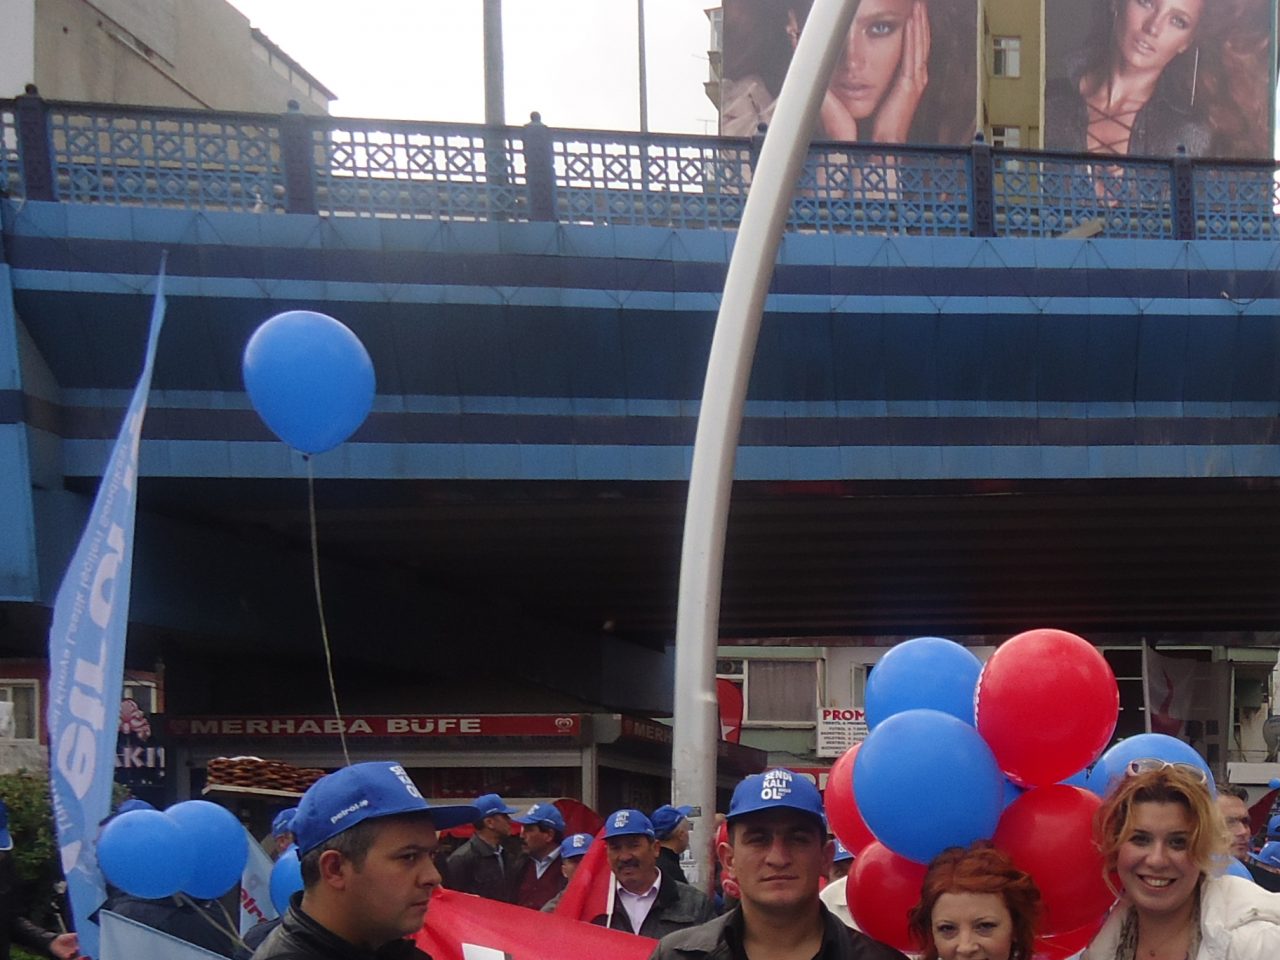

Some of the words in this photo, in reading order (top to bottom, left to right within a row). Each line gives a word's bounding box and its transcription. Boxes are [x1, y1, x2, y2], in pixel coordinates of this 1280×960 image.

[823, 709, 866, 721] PROM
[191, 719, 373, 733] MERHABA
[387, 718, 482, 733] BÜFE
[762, 778, 786, 789] KALI
[761, 788, 781, 800] OL
